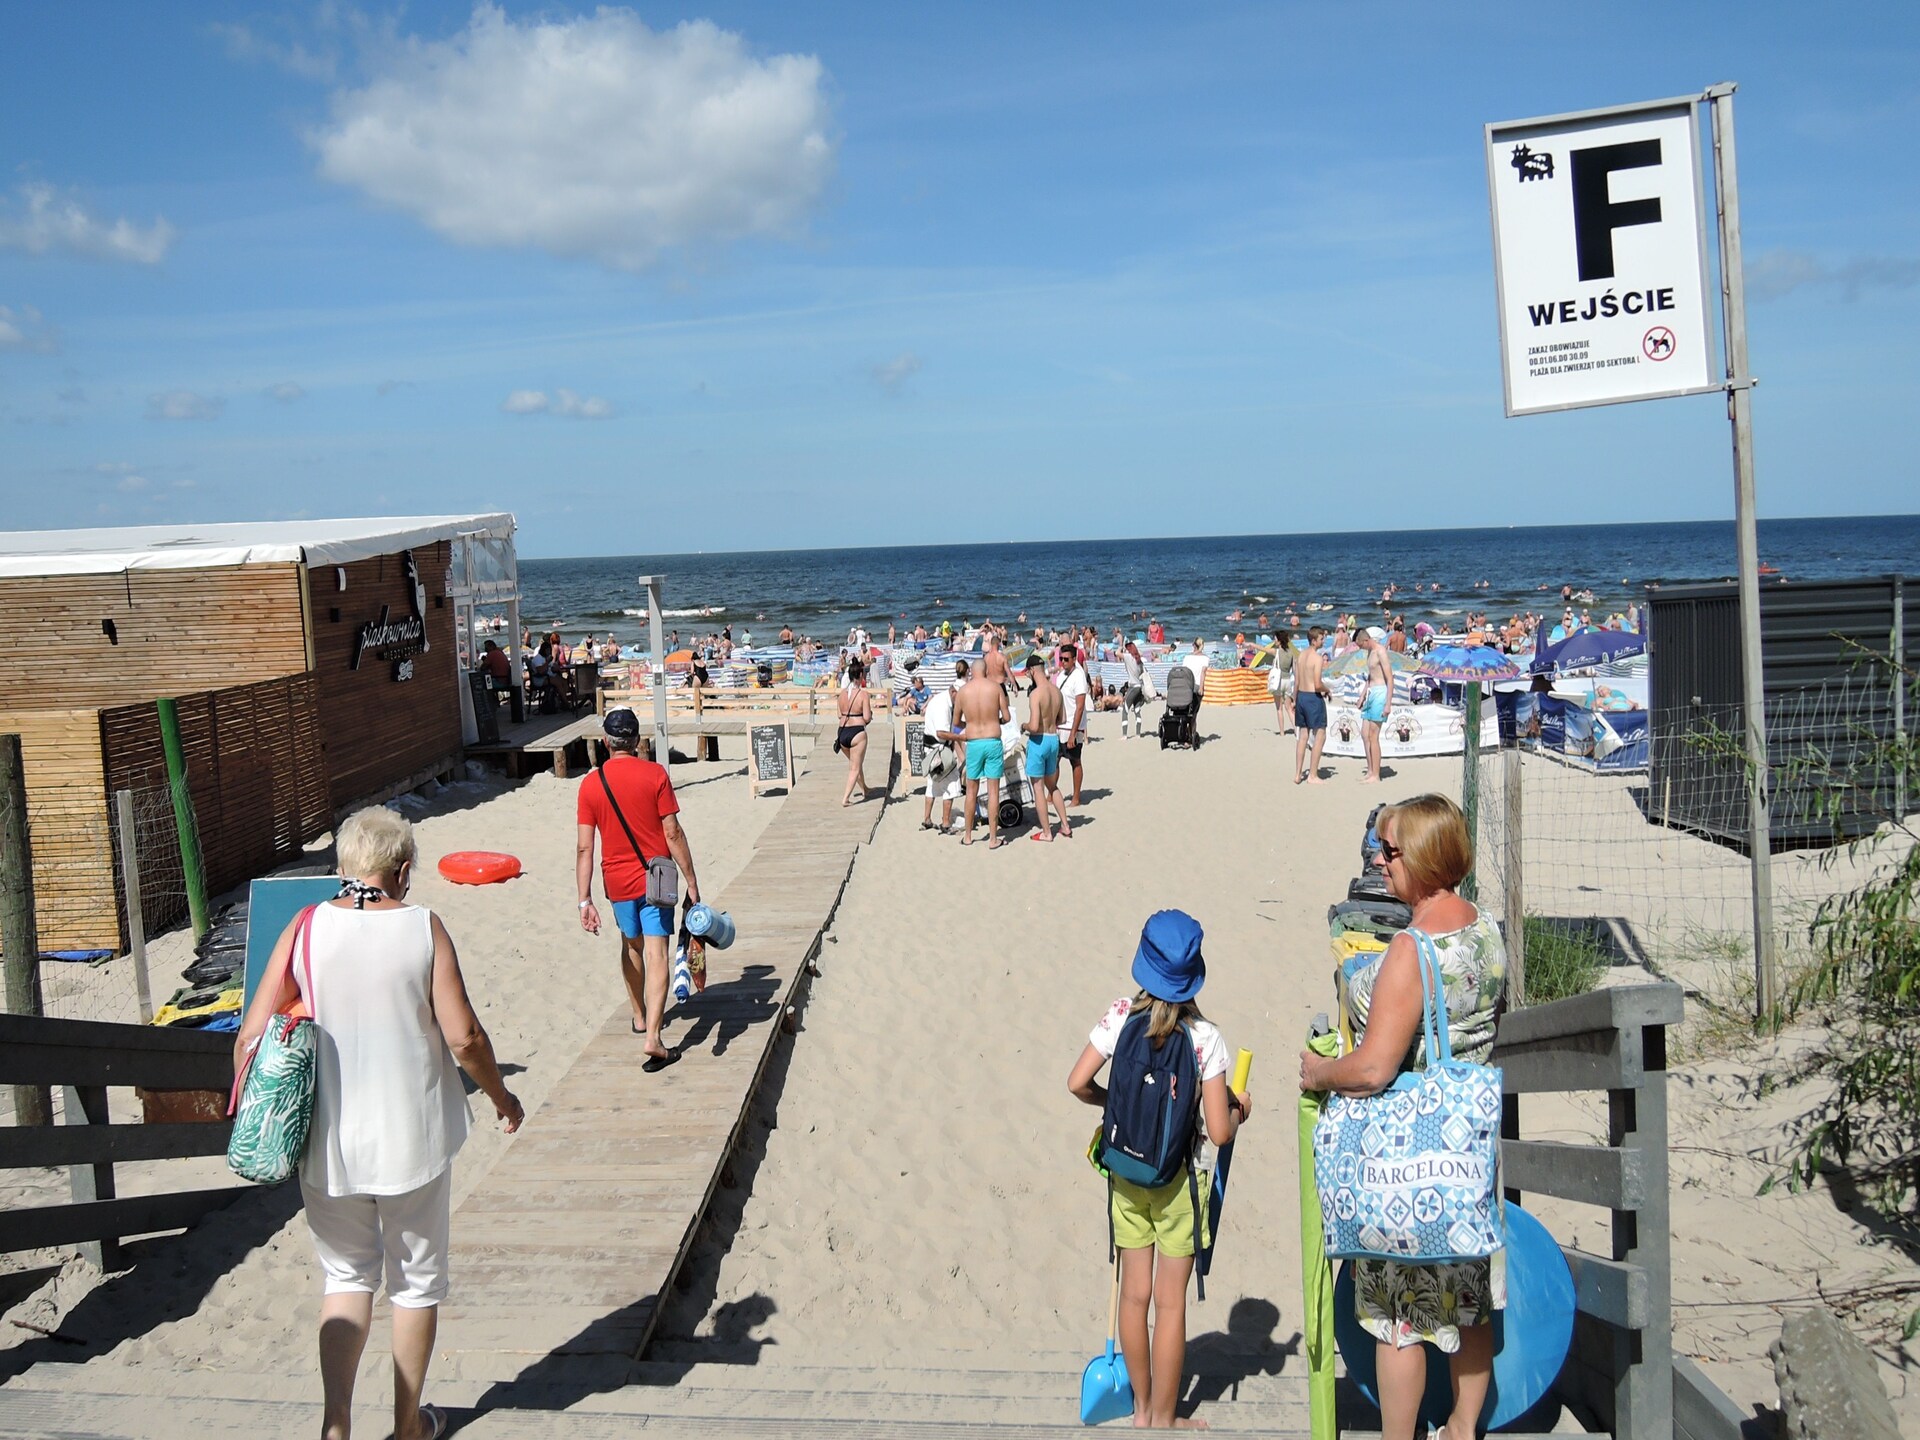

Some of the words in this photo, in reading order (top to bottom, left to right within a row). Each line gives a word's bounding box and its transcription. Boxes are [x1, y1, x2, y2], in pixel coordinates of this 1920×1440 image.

[1569, 138, 1663, 282] F
[1528, 287, 1675, 327] WEJŚCIE
[1528, 345, 1548, 355] ZAKAZ
[1549, 340, 1590, 352] OBOWIĄZUJE
[1569, 351, 1589, 361] 30.09
[1530, 366, 1549, 377] PLAŻA
[1550, 365, 1562, 374] DLA
[1563, 361, 1595, 373] ZWIERZĄT
[1596, 360, 1605, 369] OD
[1606, 357, 1636, 367] SEKTORA
[1366, 1159, 1482, 1185] BARCELONA
